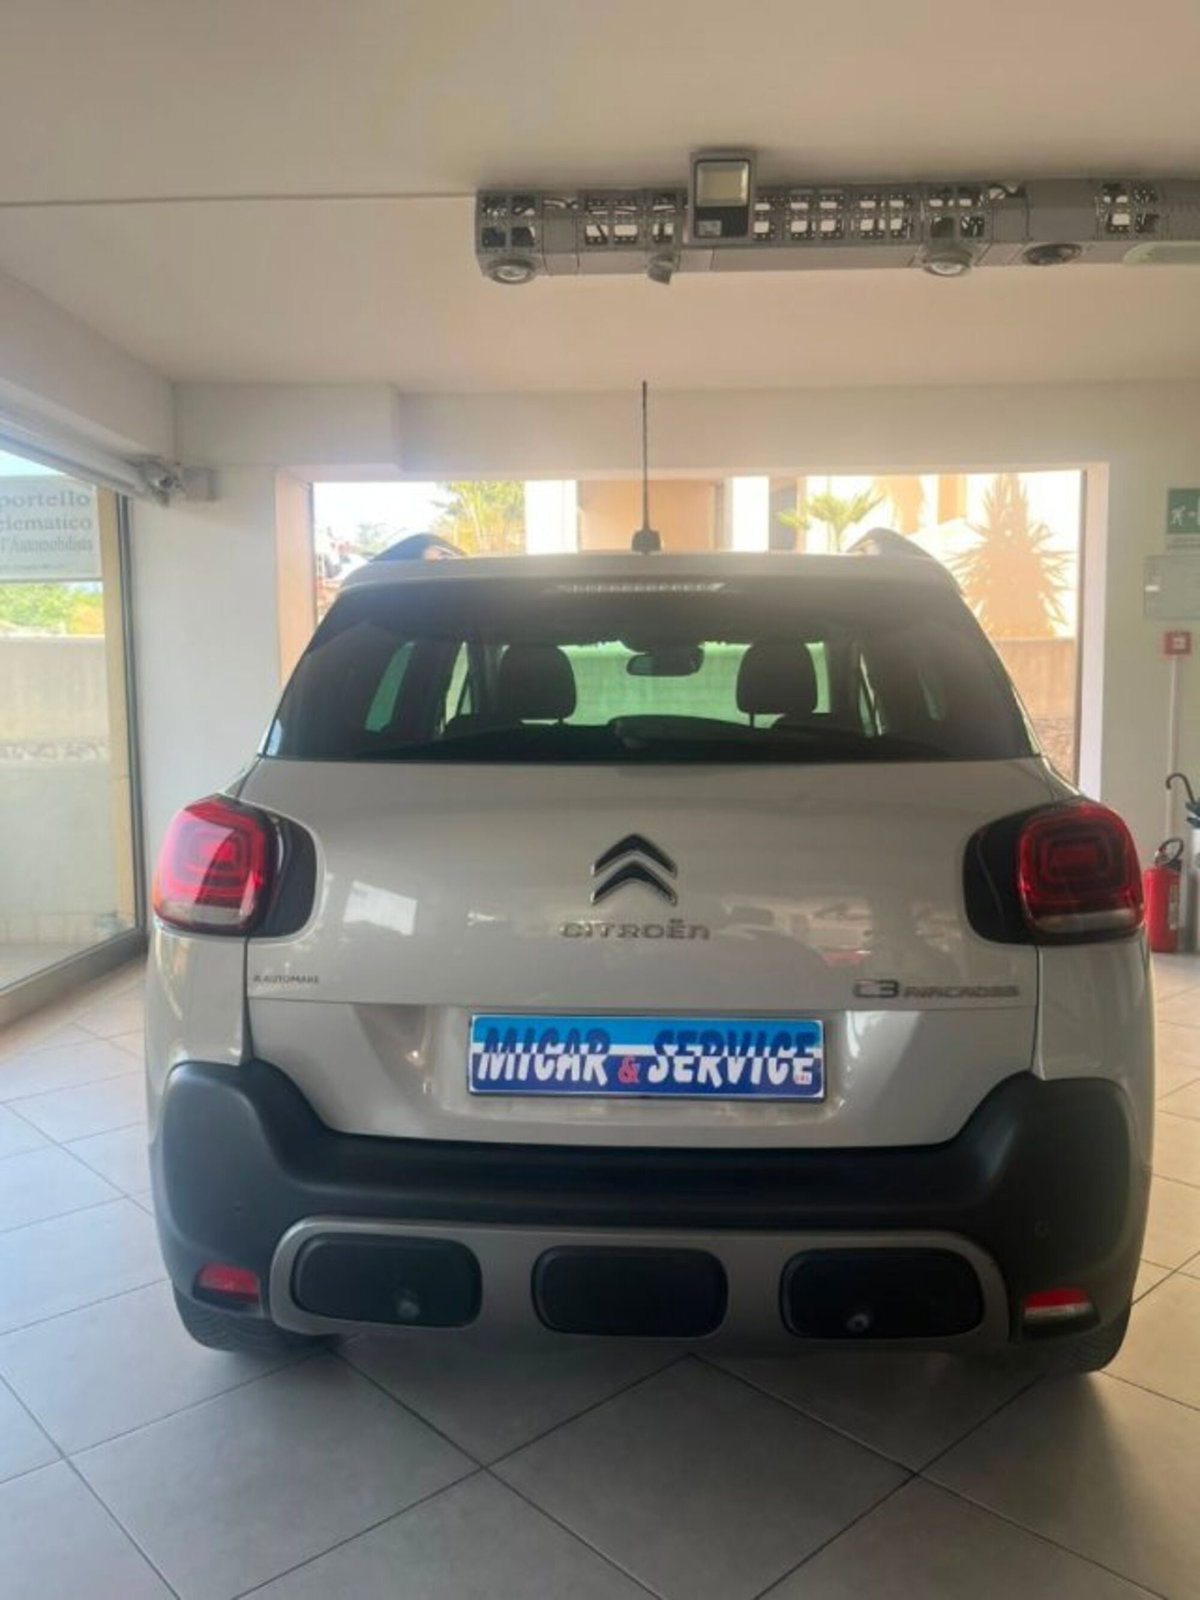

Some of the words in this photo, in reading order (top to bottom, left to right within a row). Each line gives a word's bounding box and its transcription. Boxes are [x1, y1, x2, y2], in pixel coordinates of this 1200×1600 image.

[559, 918, 710, 939] CITROËN
[853, 979, 899, 998] C3
[904, 985, 1019, 998] AIRCROSS
[477, 1027, 611, 1086] MICAR
[618, 1053, 640, 1084] &
[648, 1029, 818, 1088] SERVICE
